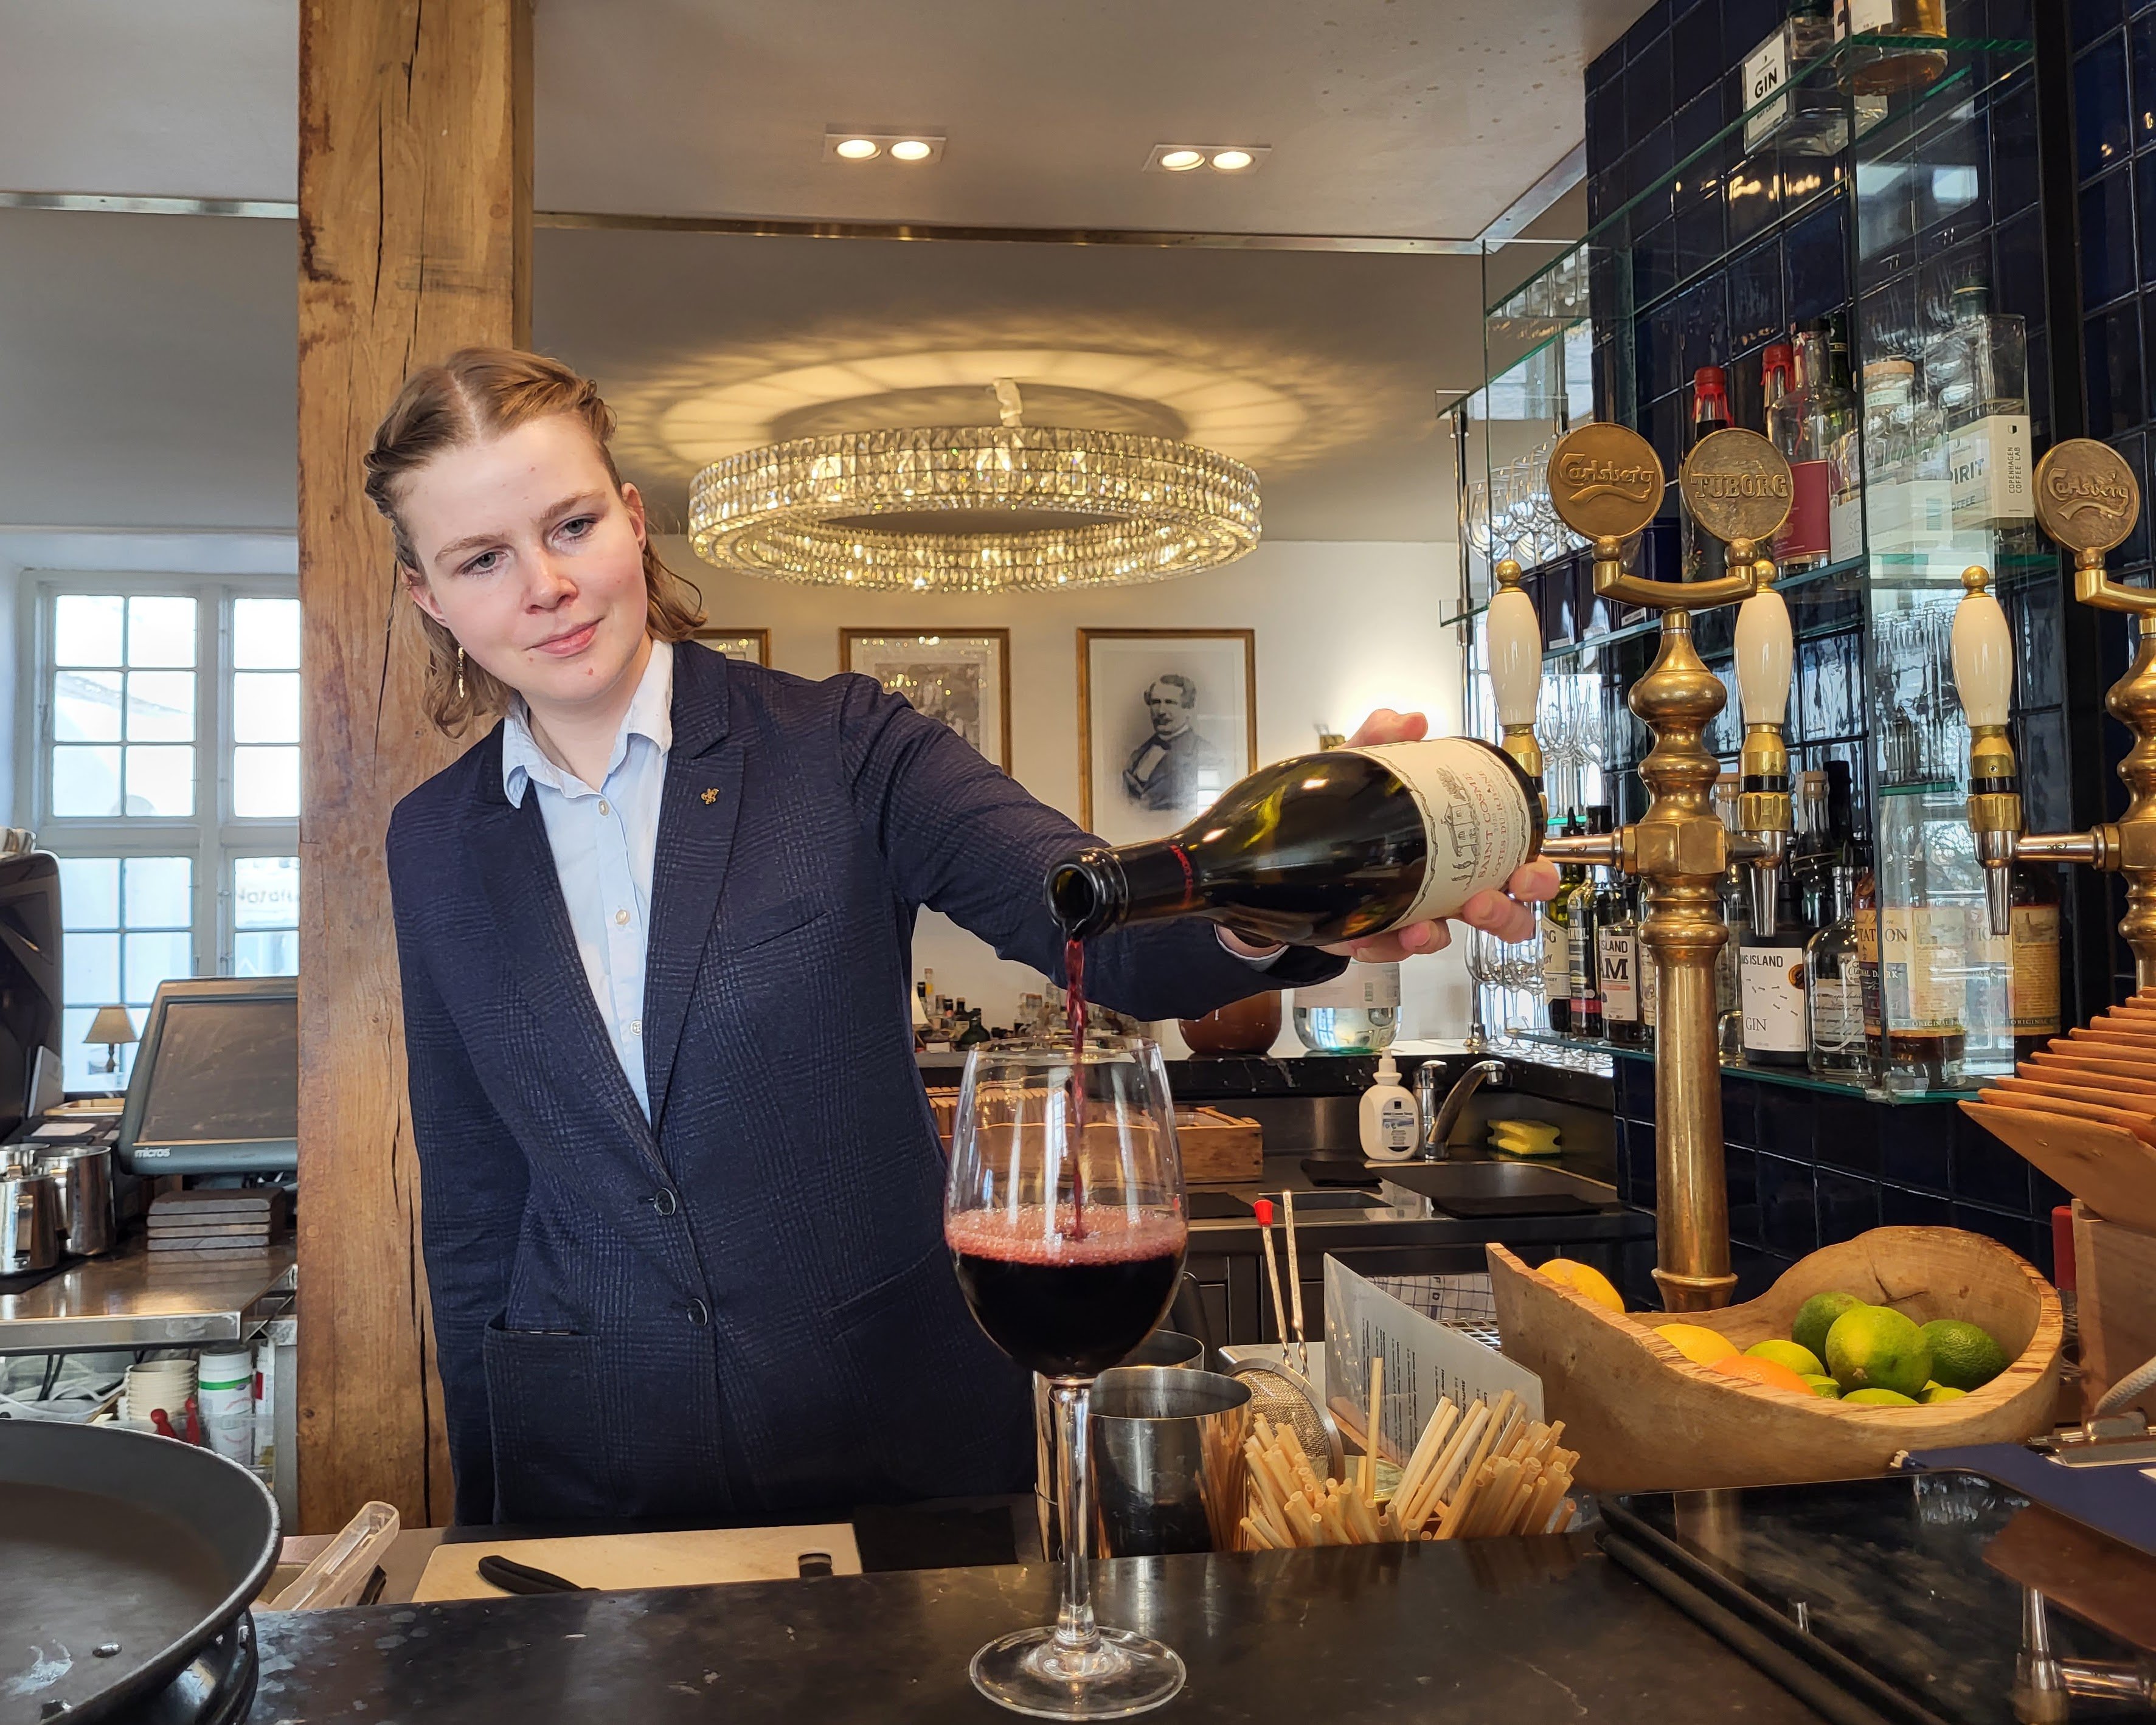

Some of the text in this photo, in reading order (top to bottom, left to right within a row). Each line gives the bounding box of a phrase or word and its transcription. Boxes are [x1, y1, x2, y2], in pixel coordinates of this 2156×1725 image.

[1755, 66, 1777, 99] GIN
[1559, 452, 1655, 494] Carlsberg
[1950, 457, 1984, 485] IRIT
[1690, 474, 1789, 499] TUBORG
[2048, 467, 2129, 505] Carlsberg
[1951, 495, 1975, 511] OFFEE
[1463, 772, 1493, 878] SAINT COSME
[1749, 954, 1783, 968] ISLAND
[1745, 1017, 1768, 1032] GIN
[134, 1147, 171, 1158] micros
